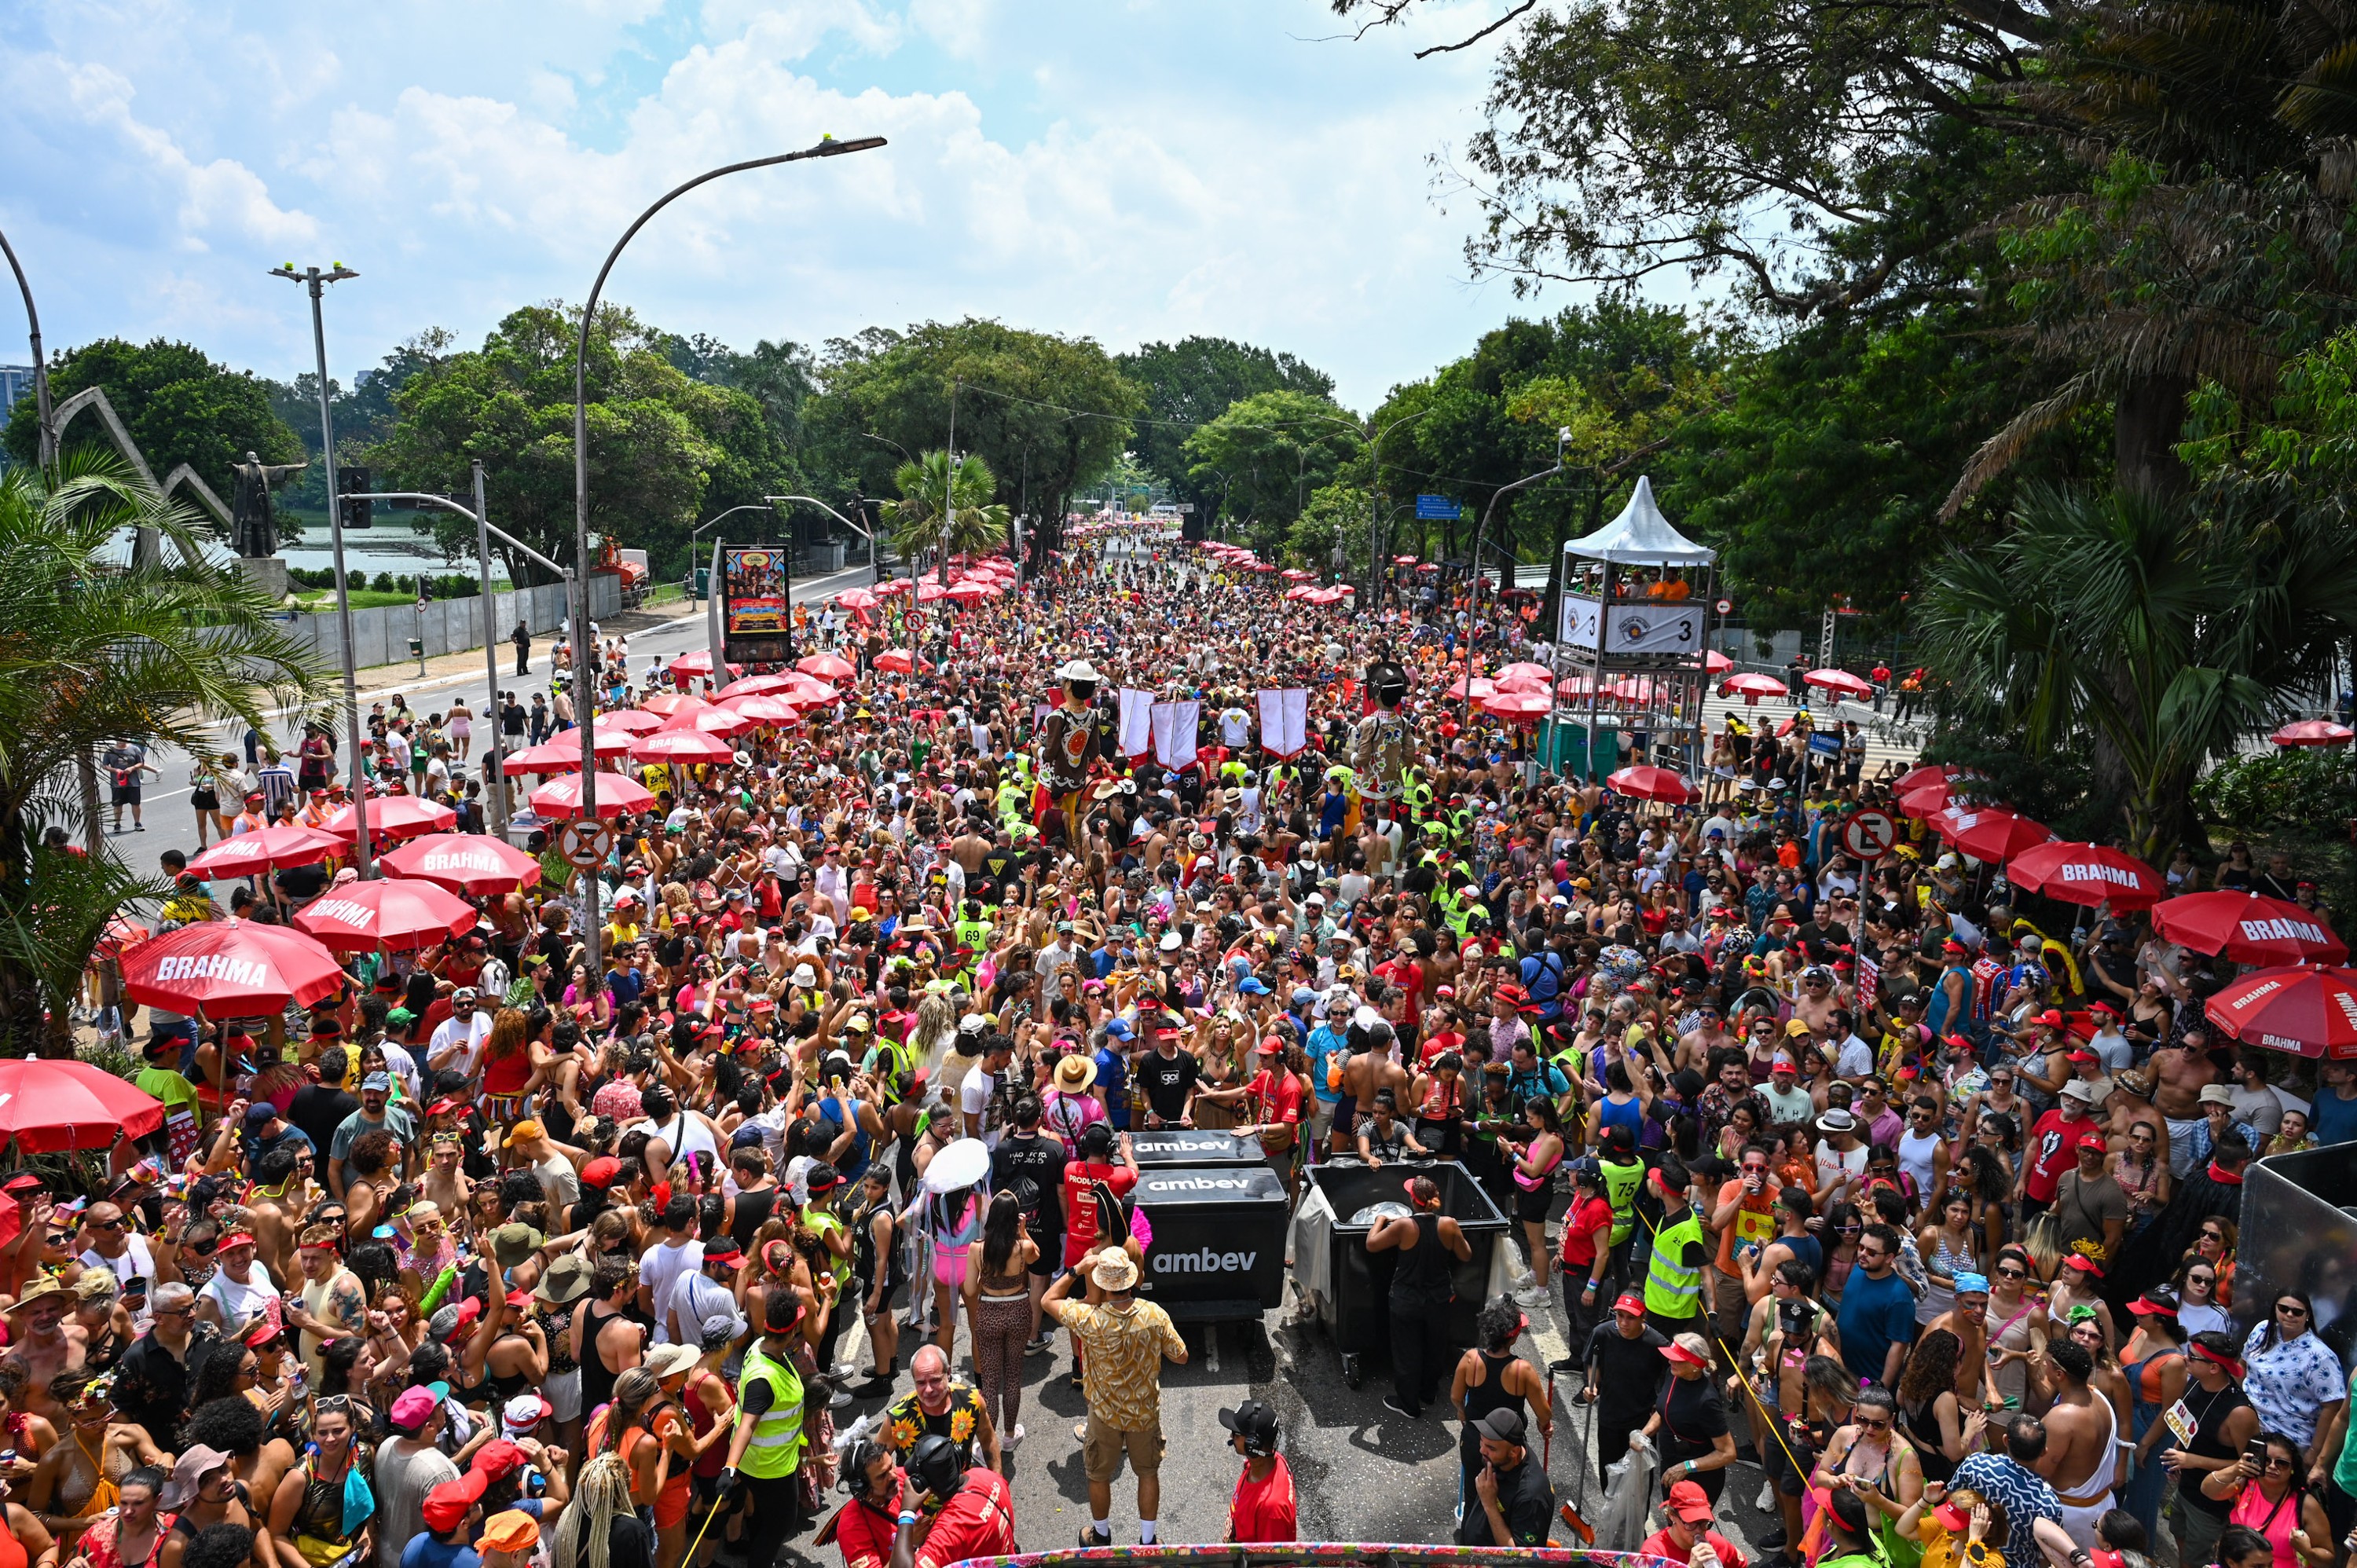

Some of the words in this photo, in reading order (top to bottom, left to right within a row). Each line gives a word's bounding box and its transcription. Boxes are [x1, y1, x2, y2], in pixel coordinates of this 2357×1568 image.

[1589, 615, 1596, 637] 3
[1678, 620, 1692, 642] 3
[648, 737, 698, 750] BRAHMA
[1015, 826, 1027, 834] 85
[1860, 819, 1881, 849] E
[424, 851, 501, 874] BRAHMA
[2062, 863, 2140, 890] BRAHMA
[306, 899, 376, 929] BRAHMA
[966, 930, 980, 941] 69
[2239, 918, 2329, 944] BRAHMA
[156, 954, 267, 988] BRAHMA
[1901, 995, 1919, 1004] UFC
[2232, 980, 2282, 1010] BRAHMA
[2262, 1034, 2302, 1052] BRAHMA
[1776, 1105, 1784, 1115] H
[1135, 1140, 1231, 1152] ambev
[1148, 1177, 1249, 1192] ambev
[1618, 1181, 1636, 1198] 75
[1153, 1247, 1257, 1273] ambev
[2176, 1405, 2187, 1420] EU
